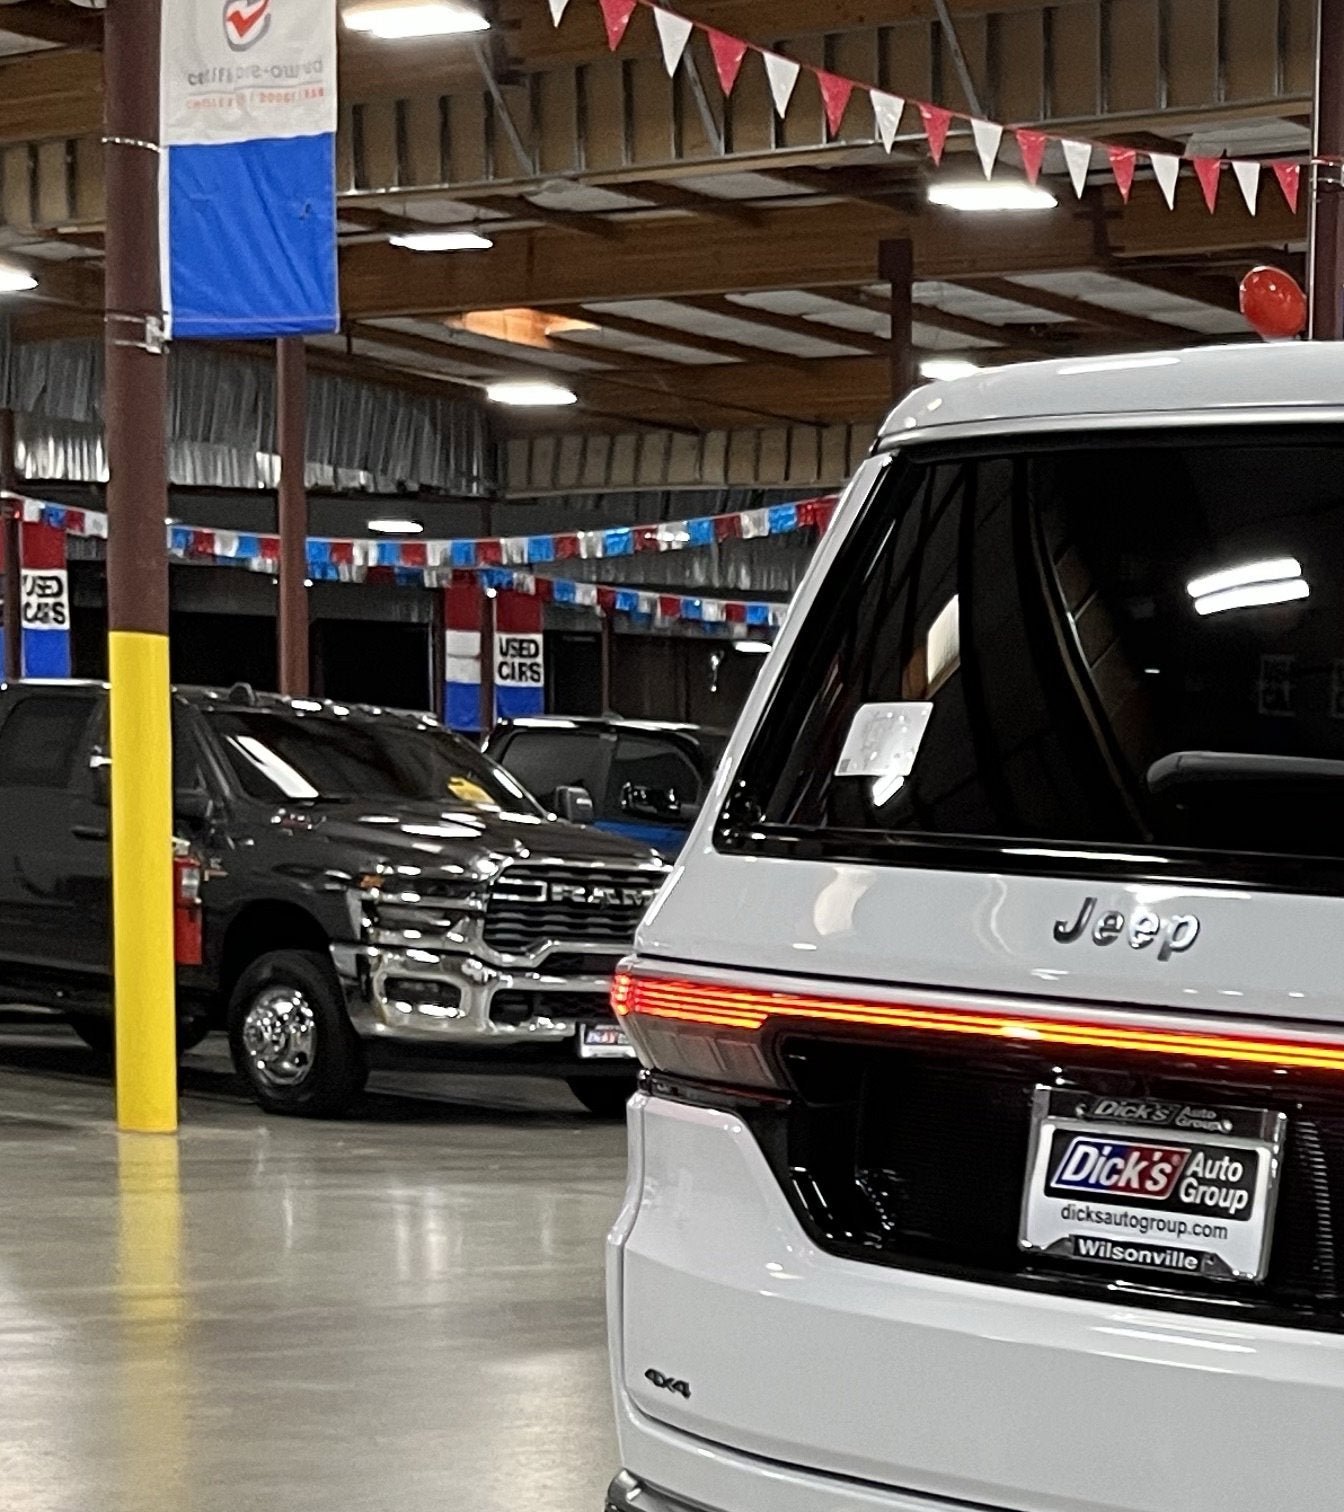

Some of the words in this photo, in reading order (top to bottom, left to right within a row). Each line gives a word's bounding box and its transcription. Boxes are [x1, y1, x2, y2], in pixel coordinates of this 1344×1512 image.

[499, 637, 540, 659] USED
[1053, 896, 1200, 962] Jeep
[1093, 1099, 1171, 1122] Dick's
[1060, 1143, 1173, 1192] Dick's
[1185, 1151, 1244, 1183] Auto
[1179, 1176, 1249, 1215] Group
[1060, 1203, 1229, 1240] dicksautogroup.com
[1077, 1238, 1199, 1271] Wilsonville
